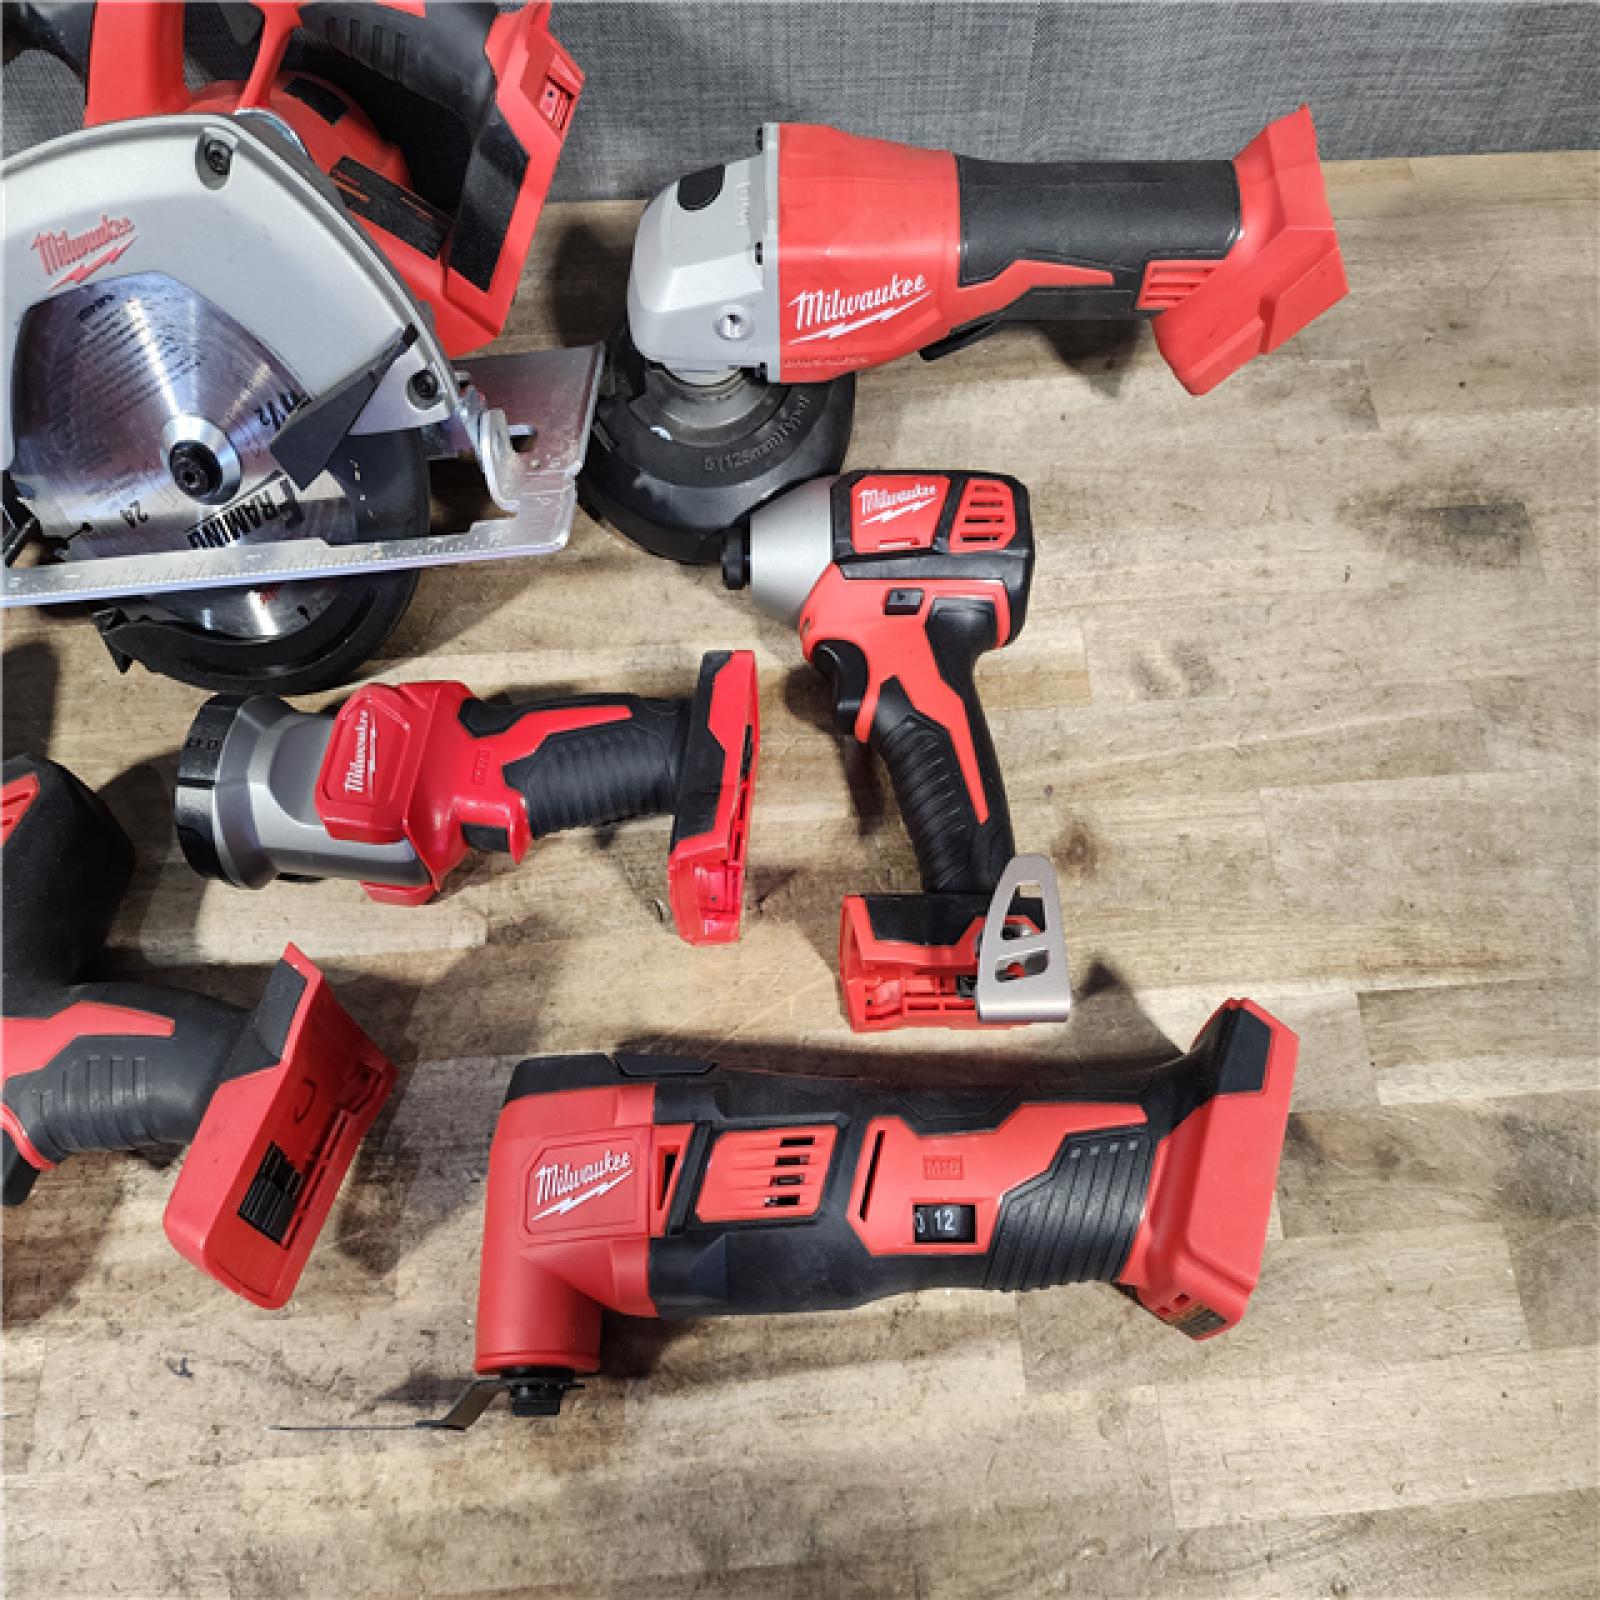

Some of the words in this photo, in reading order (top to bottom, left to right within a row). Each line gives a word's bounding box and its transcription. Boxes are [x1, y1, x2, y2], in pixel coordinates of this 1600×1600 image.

[30, 215, 135, 276] Milwaukee
[786, 272, 926, 331] Milwaukee
[857, 484, 936, 516] Milwaukee
[343, 709, 369, 793] Milwaukee
[534, 1149, 631, 1206] Milwaukee
[934, 1209, 955, 1231] 12
